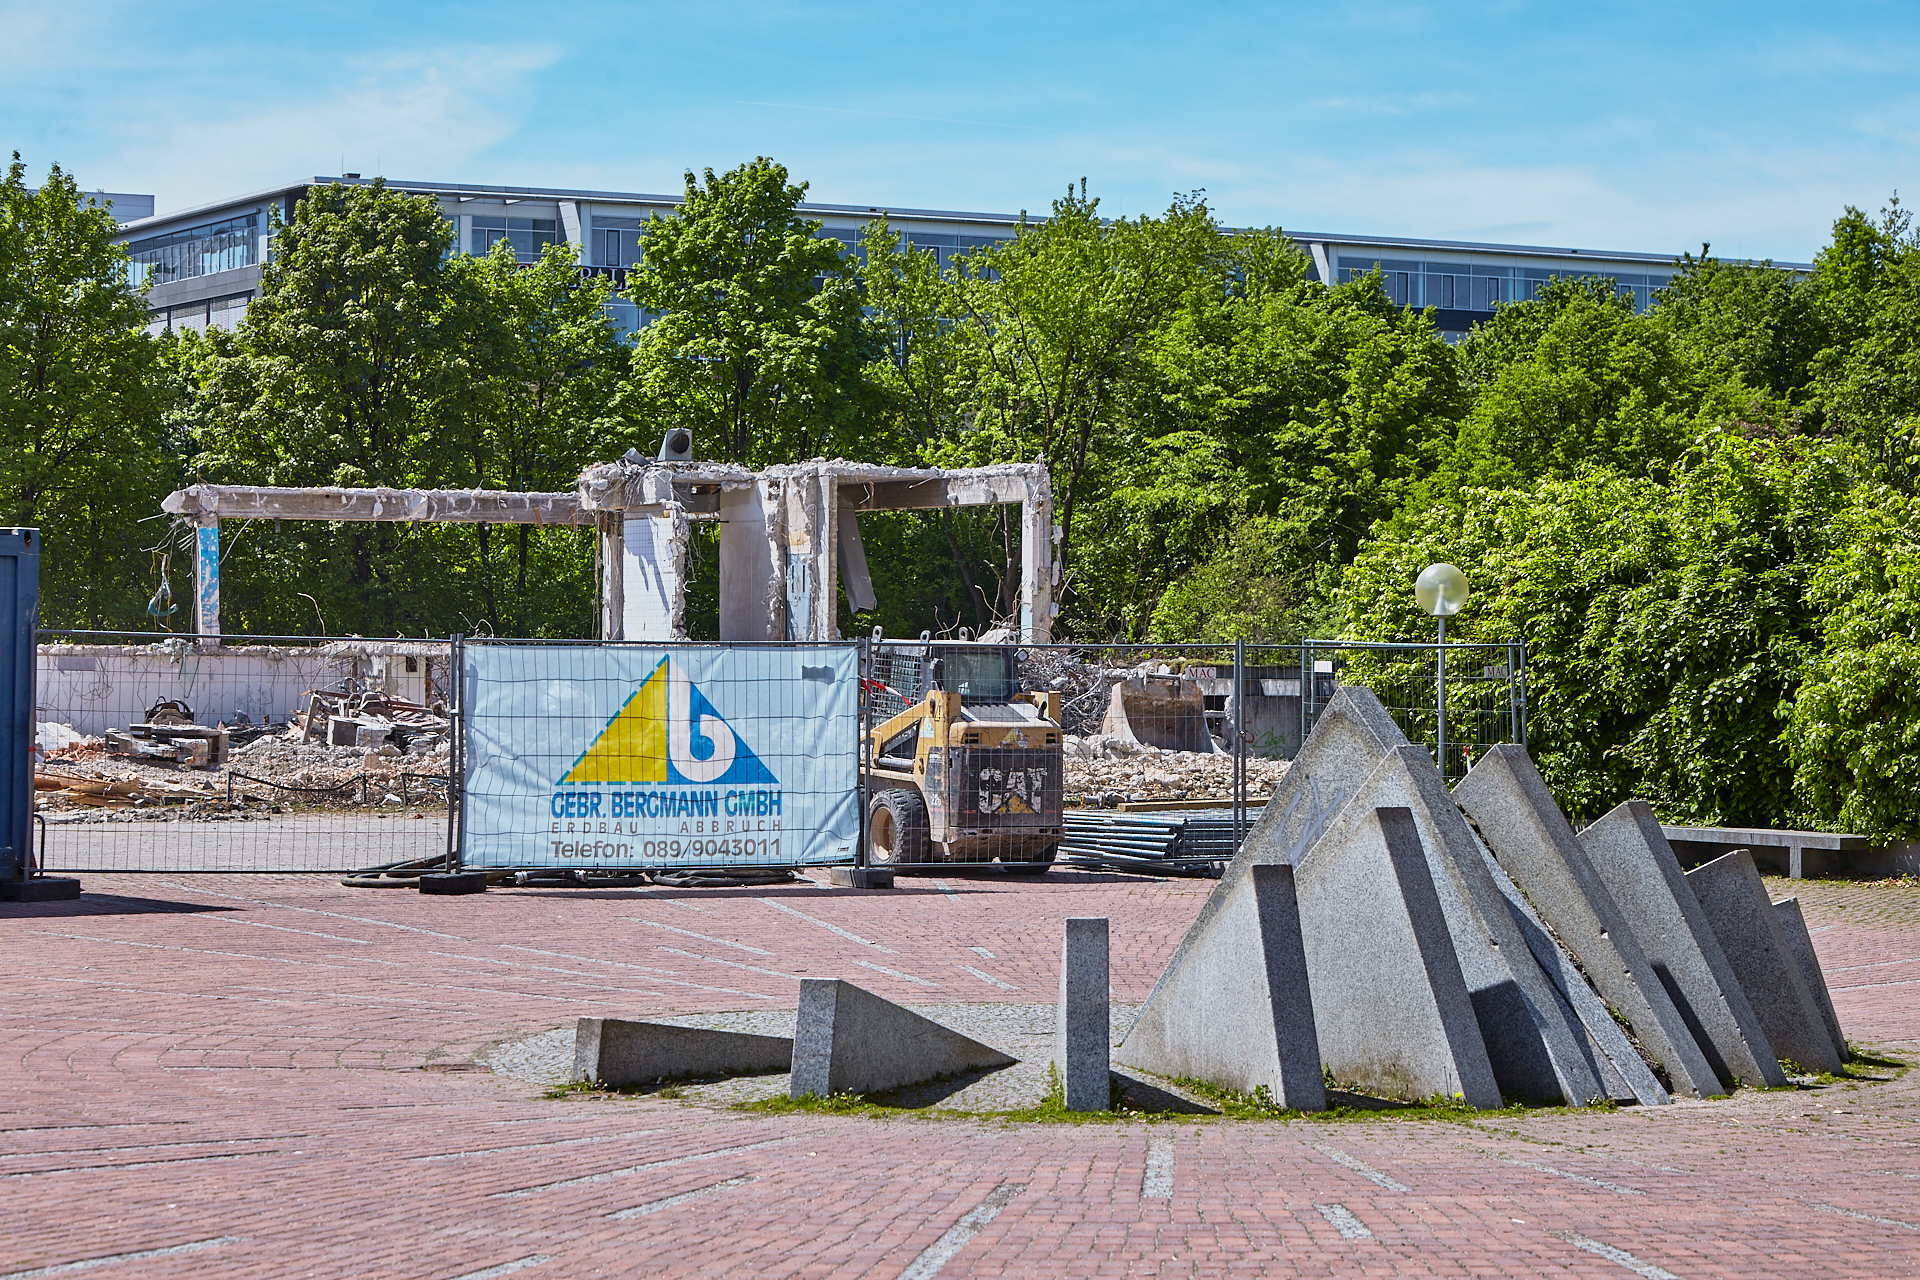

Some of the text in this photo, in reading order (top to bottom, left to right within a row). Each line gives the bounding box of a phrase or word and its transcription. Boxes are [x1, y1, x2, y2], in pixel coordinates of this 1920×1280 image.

[1188, 667, 1215, 679] MAC
[1487, 666, 1507, 677] MAC
[979, 767, 1048, 814] CAT
[551, 789, 782, 819] GEBR. BERGMANN GMBH
[551, 819, 781, 834] ERDBAU ABBRUCH
[550, 838, 780, 859] Telefon: 089/9043011
